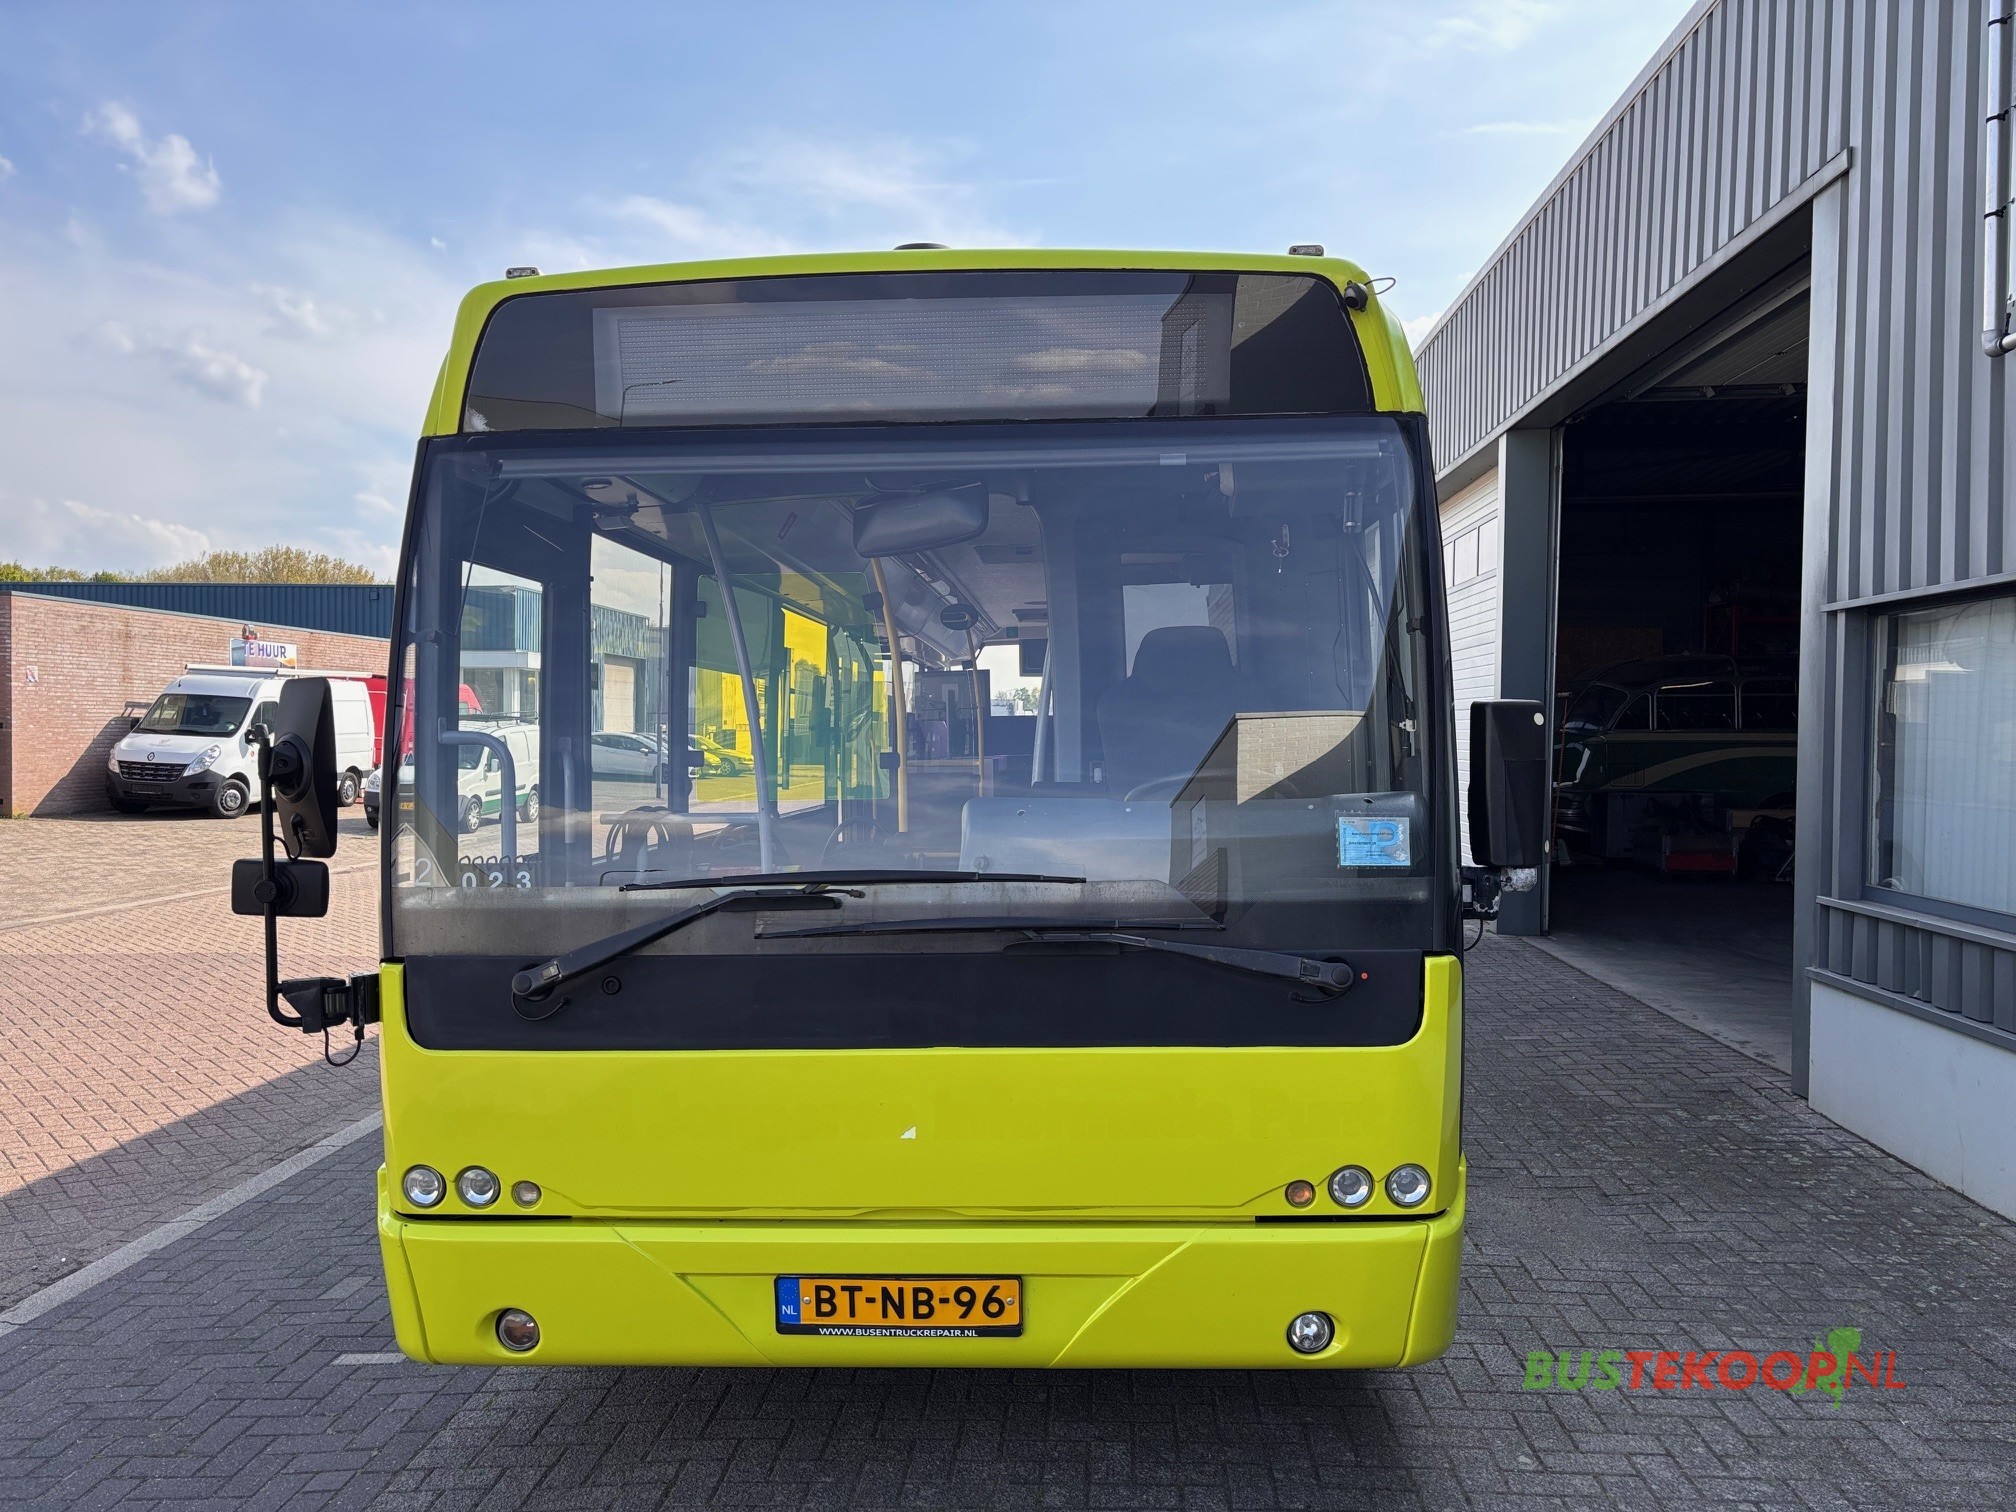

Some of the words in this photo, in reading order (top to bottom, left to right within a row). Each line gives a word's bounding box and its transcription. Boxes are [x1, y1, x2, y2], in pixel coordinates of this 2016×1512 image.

[243, 642, 255, 656] TE
[257, 643, 287, 658] HUUR
[782, 1305, 798, 1315] NL
[814, 1284, 1006, 1320] BT-NB-96
[819, 1327, 979, 1337] WWW.BUSENTRUCKREPAIR.NL
